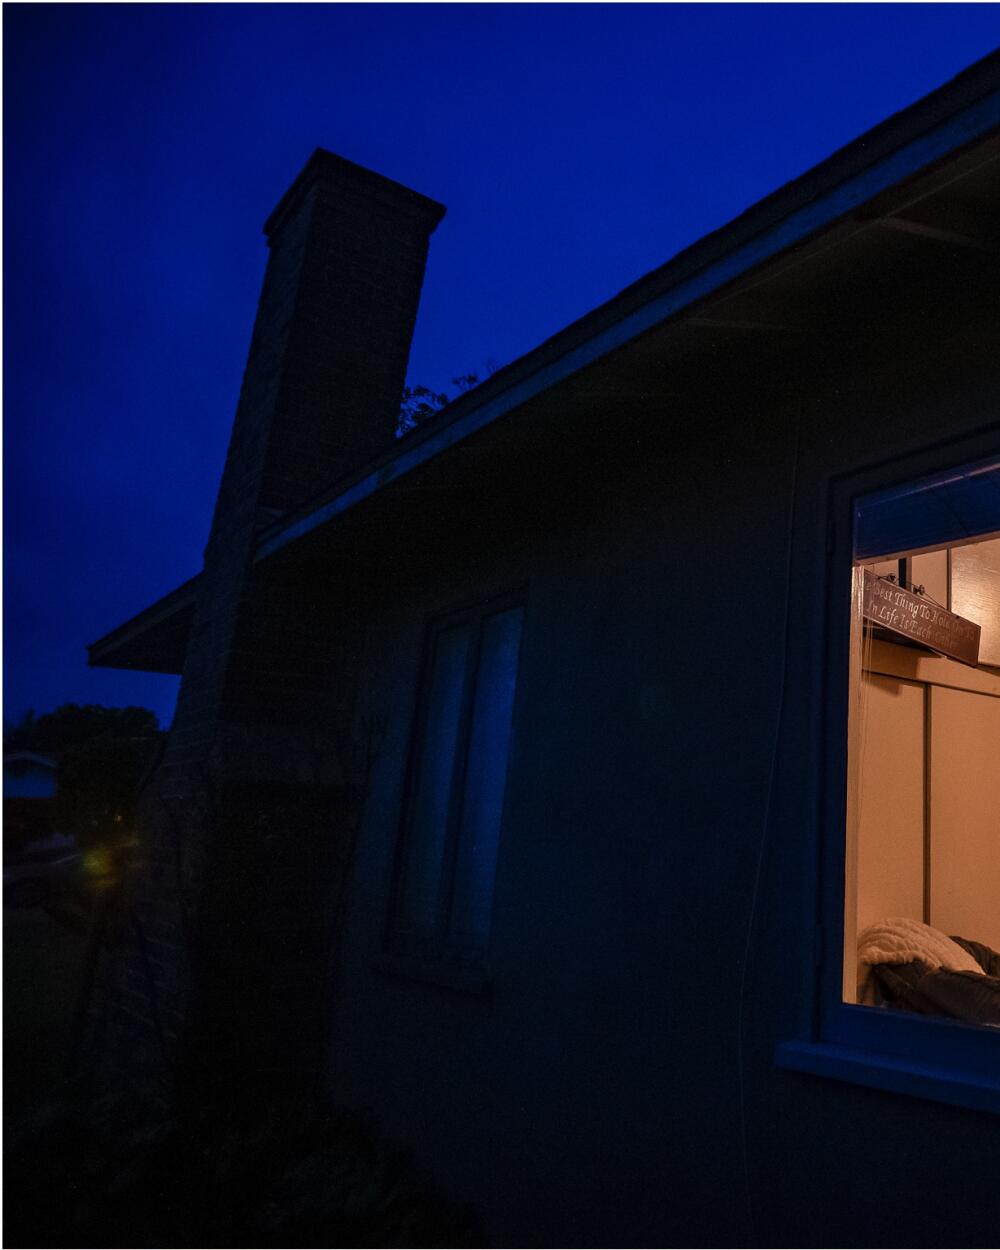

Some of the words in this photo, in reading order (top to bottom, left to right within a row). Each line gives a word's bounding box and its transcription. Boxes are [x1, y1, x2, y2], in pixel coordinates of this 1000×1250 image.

[868, 600, 878, 616] In
[879, 605, 899, 626] Life
[900, 614, 911, 631] Is
[910, 619, 931, 639] Each
[894, 592, 920, 619] Thing
[920, 604, 931, 620] To
